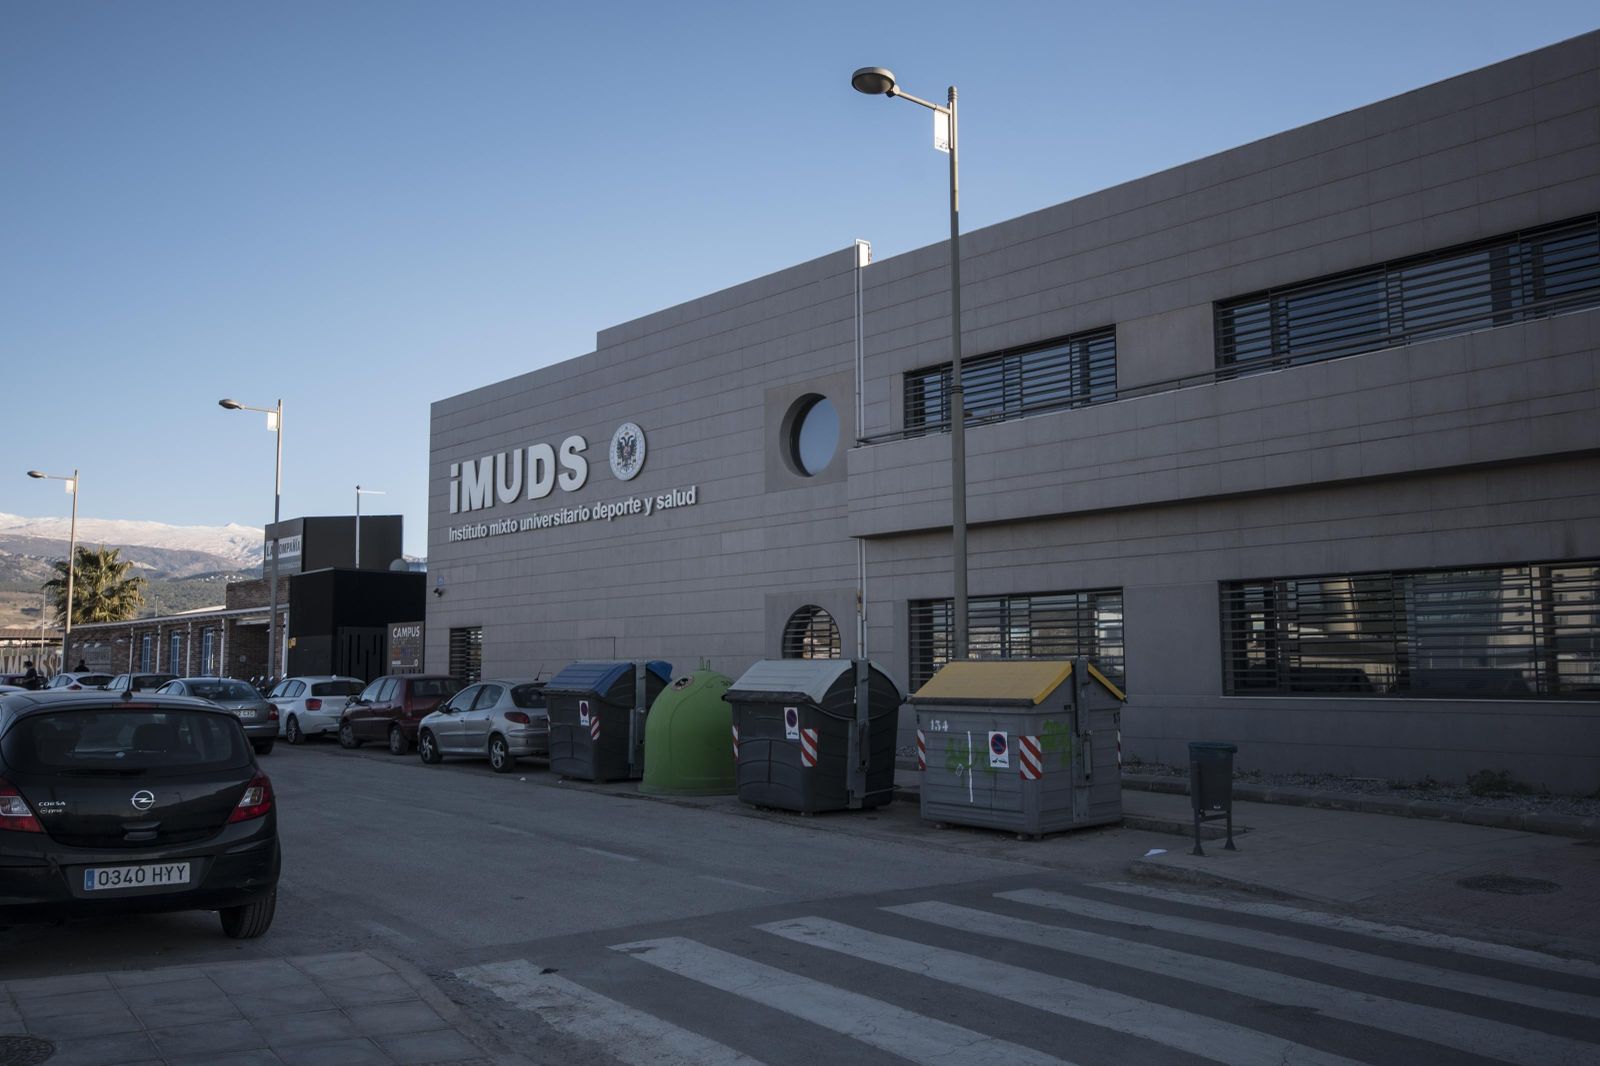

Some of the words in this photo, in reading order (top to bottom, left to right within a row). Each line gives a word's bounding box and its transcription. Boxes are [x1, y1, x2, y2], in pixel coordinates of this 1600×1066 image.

[450, 435, 588, 514] iMUDS
[449, 525, 487, 542] Instituto
[489, 519, 518, 536] mixto
[520, 505, 590, 531] universitario
[592, 497, 642, 521] deporte
[644, 497, 653, 516] y
[656, 485, 696, 510] salud
[392, 626, 420, 638] CAMPUS
[98, 868, 146, 886] 0340
[152, 865, 186, 883] HYY
